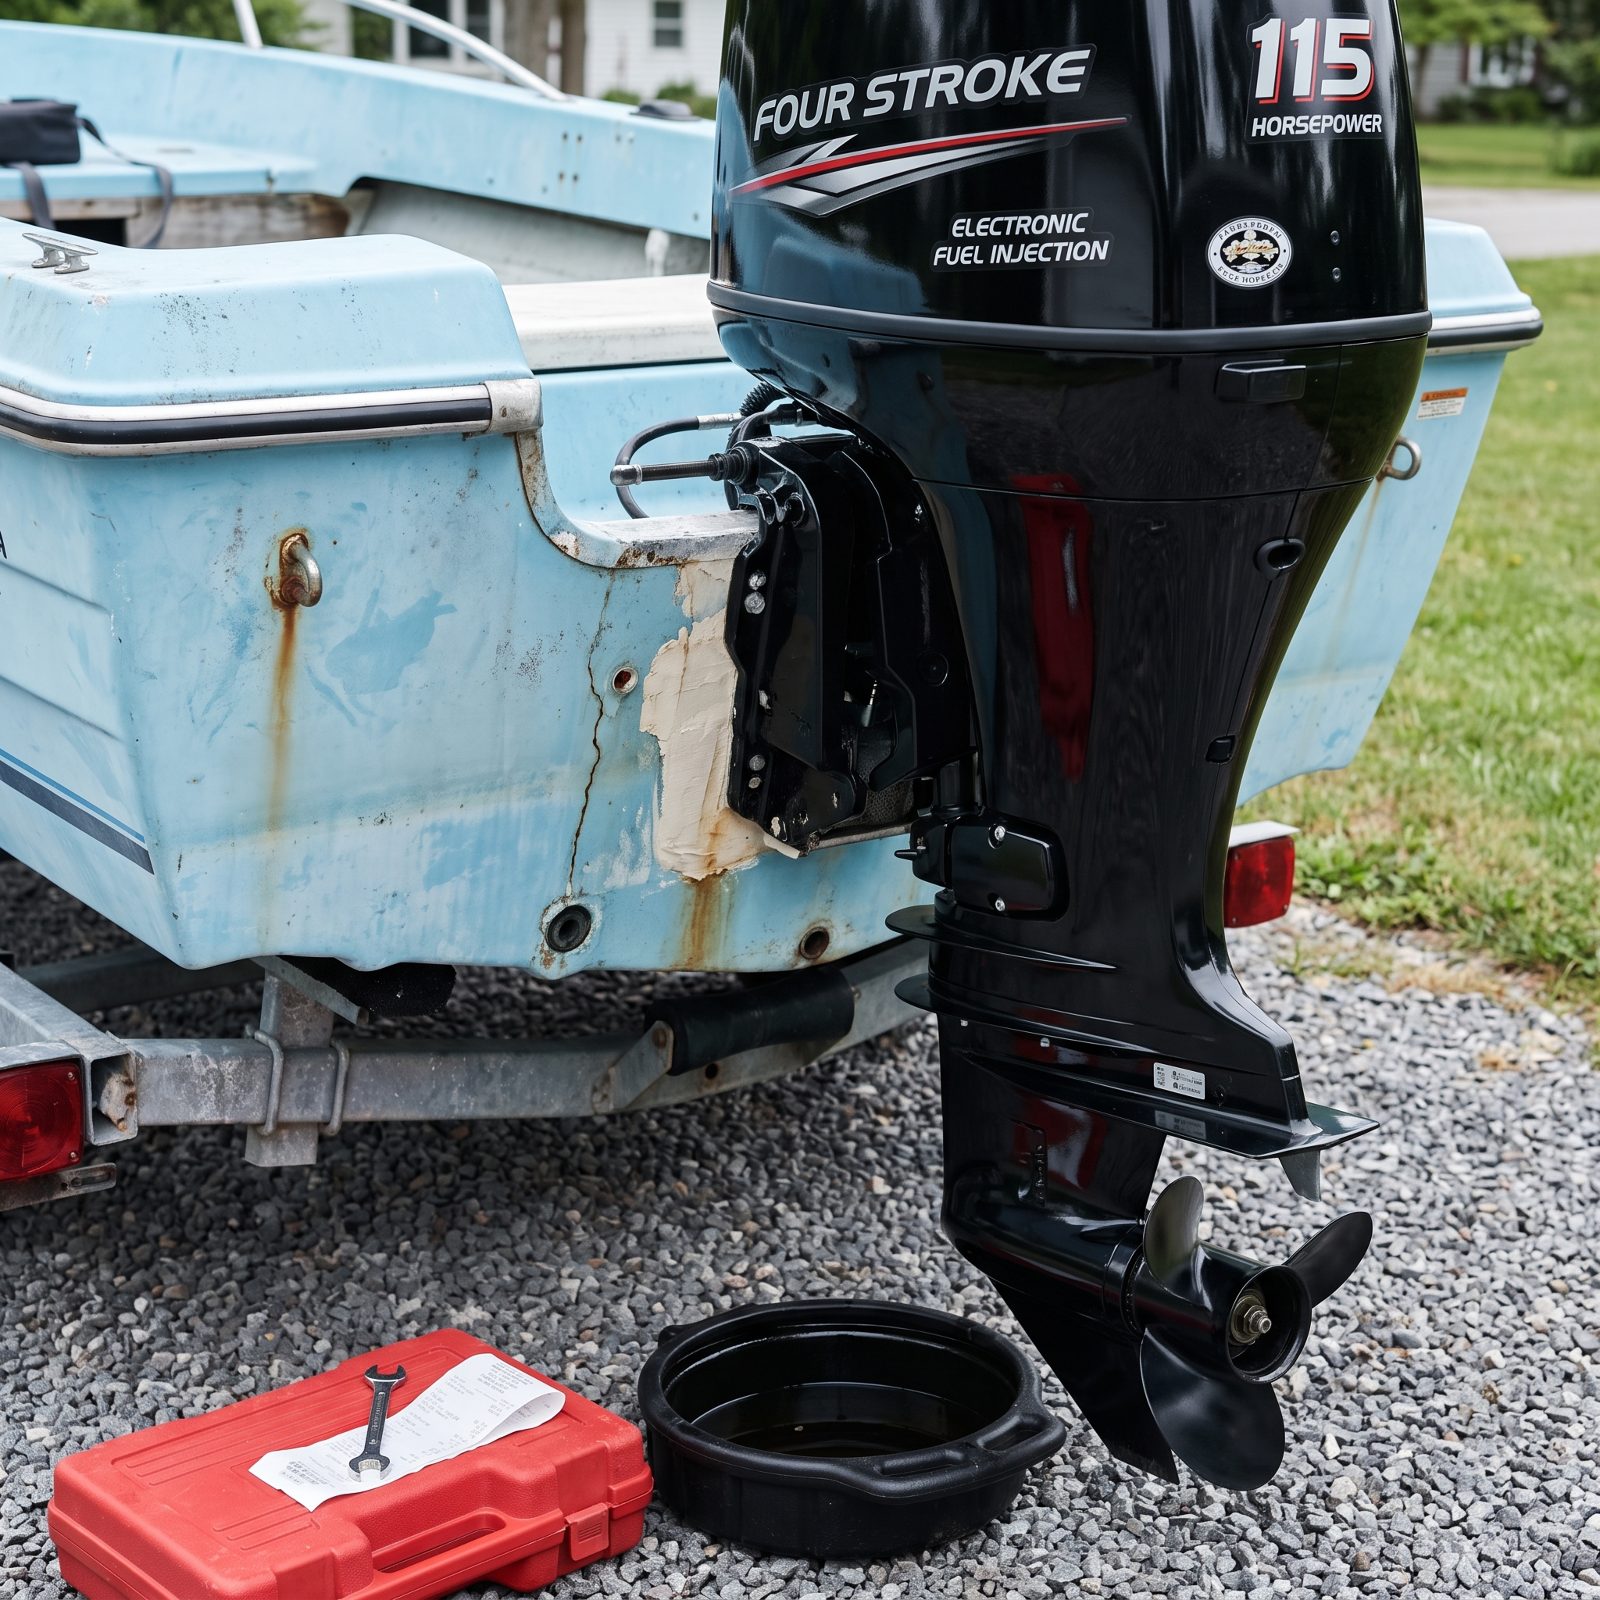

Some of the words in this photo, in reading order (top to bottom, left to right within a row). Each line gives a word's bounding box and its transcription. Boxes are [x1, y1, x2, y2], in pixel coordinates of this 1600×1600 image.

[1252, 18, 1375, 104] 115
[753, 83, 854, 141] FOUR
[863, 50, 1090, 117] STROKE
[1251, 114, 1382, 137] HORSEPOWER
[952, 213, 1088, 238] ELECTRONIC
[933, 245, 984, 266] FUEL
[990, 240, 1110, 264] INJECTION
